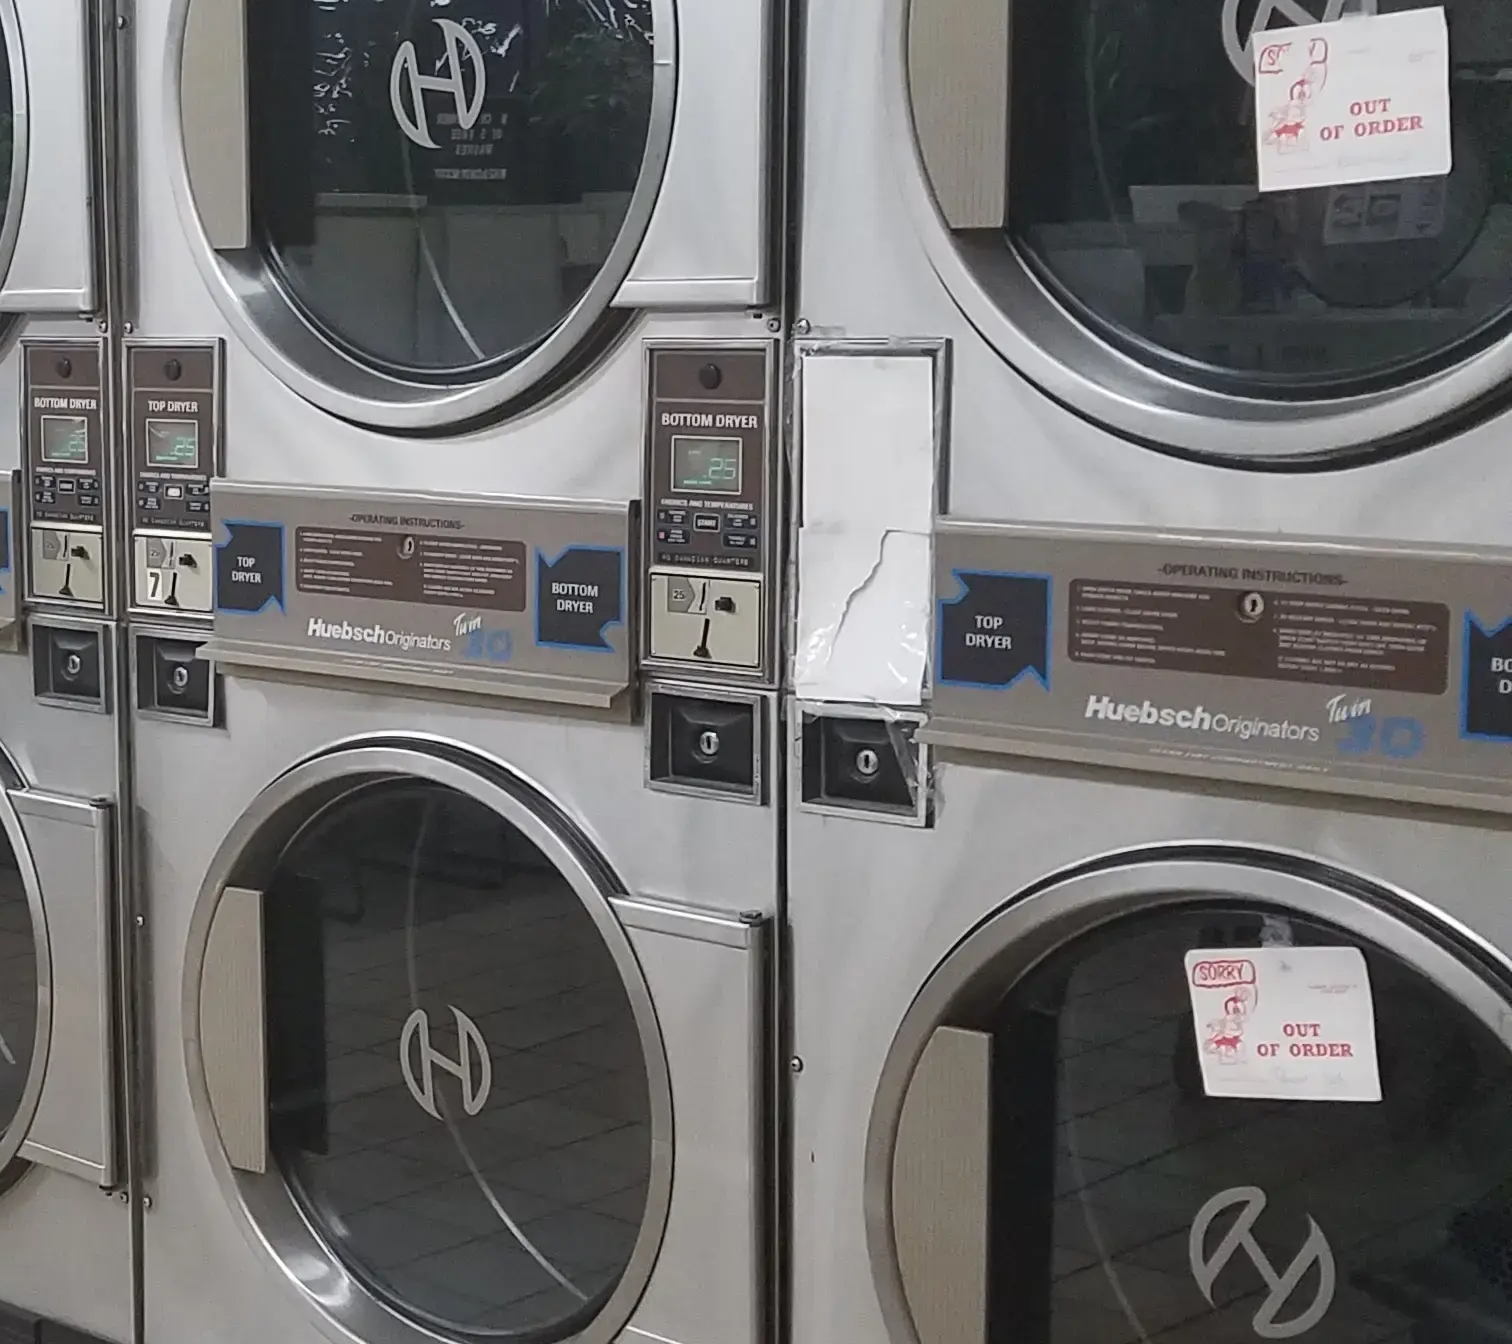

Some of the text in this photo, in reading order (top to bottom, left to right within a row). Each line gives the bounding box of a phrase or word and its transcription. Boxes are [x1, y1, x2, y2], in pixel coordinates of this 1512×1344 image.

[1350, 98, 1391, 116] OUT
[1354, 115, 1424, 138] ORDER
[34, 397, 97, 410] BOTTOM DRYER
[148, 400, 198, 413] TOP DRYER
[661, 413, 758, 428] BOTTOM DRYER
[236, 556, 256, 568] TOP
[231, 570, 262, 584] DRYER
[149, 572, 161, 598] 7
[551, 581, 599, 598] BOTTOM
[673, 589, 685, 600] 25
[556, 599, 594, 614] DRYER
[974, 615, 1004, 630] TOP
[965, 633, 1013, 651] DRYER
[1326, 694, 1372, 724] Twin
[1199, 962, 1244, 981] SORRY
[1283, 1023, 1321, 1038] OUT
[1257, 1043, 1354, 1058] OF ORDER
